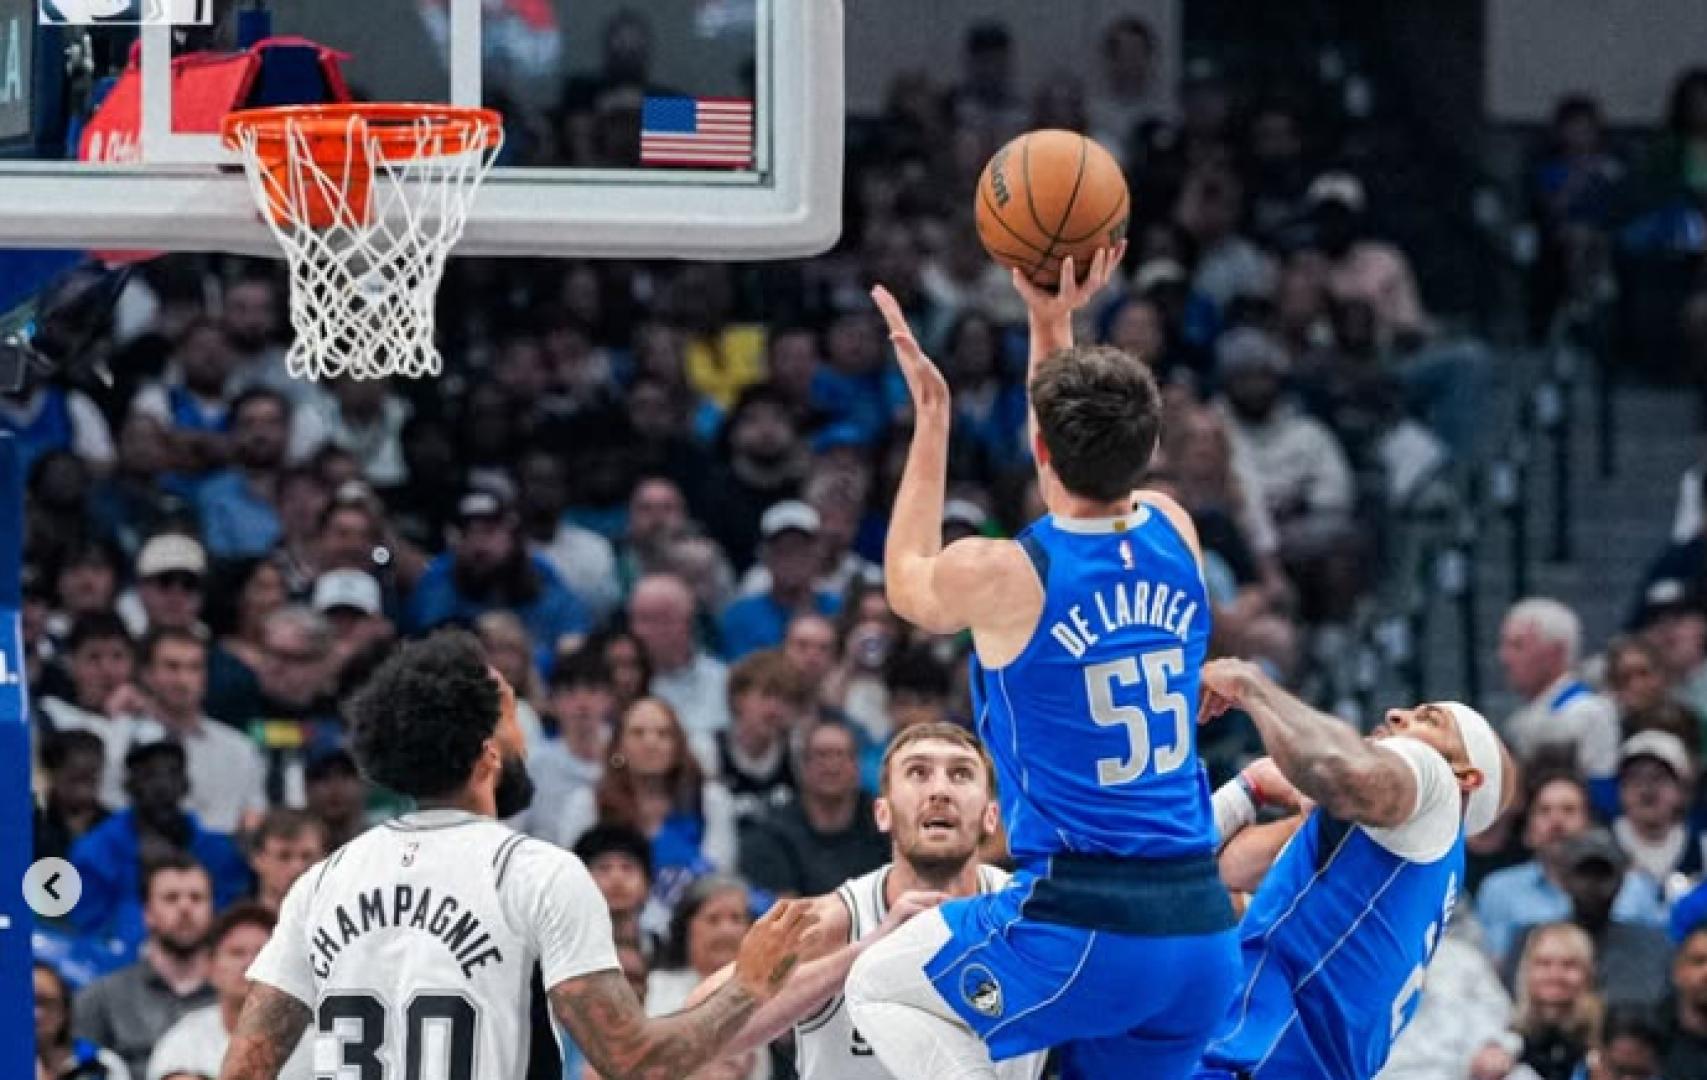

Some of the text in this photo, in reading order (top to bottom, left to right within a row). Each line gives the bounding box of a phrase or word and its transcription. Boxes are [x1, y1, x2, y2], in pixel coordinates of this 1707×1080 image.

[1050, 581, 1197, 659] DE LARREA
[1085, 648, 1191, 786] 55
[310, 884, 503, 979] CHAMPAGNIE
[314, 989, 481, 1080] 30
